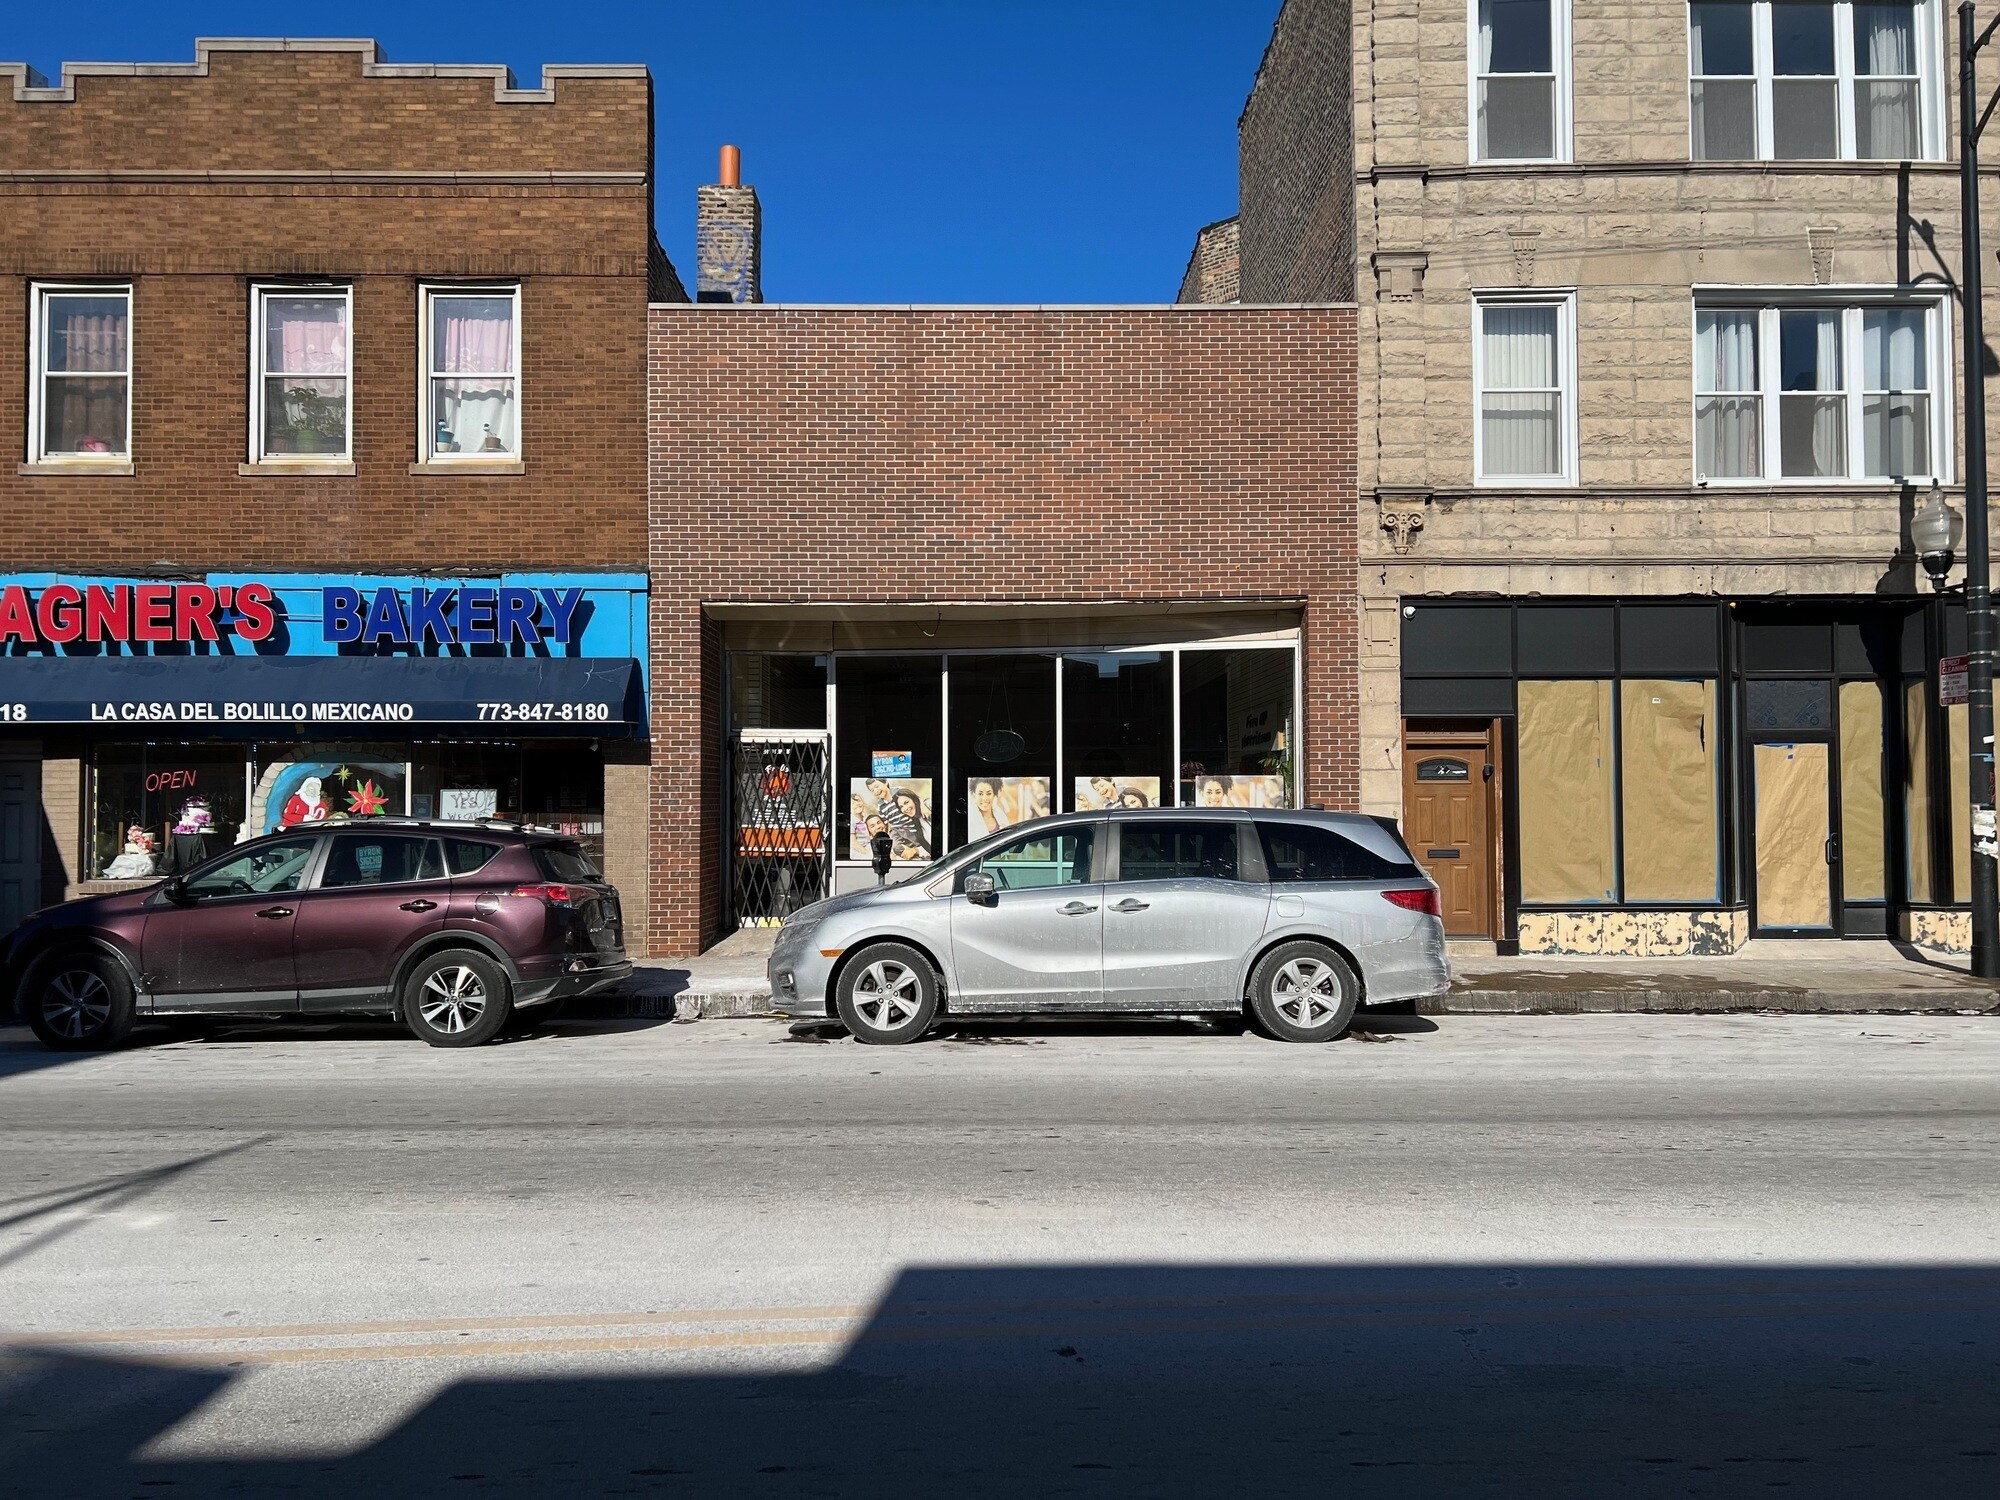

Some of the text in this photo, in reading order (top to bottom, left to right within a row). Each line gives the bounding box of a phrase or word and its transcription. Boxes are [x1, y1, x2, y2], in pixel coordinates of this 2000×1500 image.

[0, 582, 584, 643] AGNER'S BAKERY
[1942, 665, 1968, 674] CLEANING
[91, 703, 118, 720] LA
[120, 703, 176, 721] CASA
[180, 703, 219, 720] DEL
[224, 703, 307, 721] BOLILLO
[311, 703, 414, 721] MEXICANO
[476, 703, 609, 721] 773-847-8180
[978, 740, 1020, 752] OPEN
[145, 769, 197, 792] OPEN
[359, 847, 381, 857] BYRON
